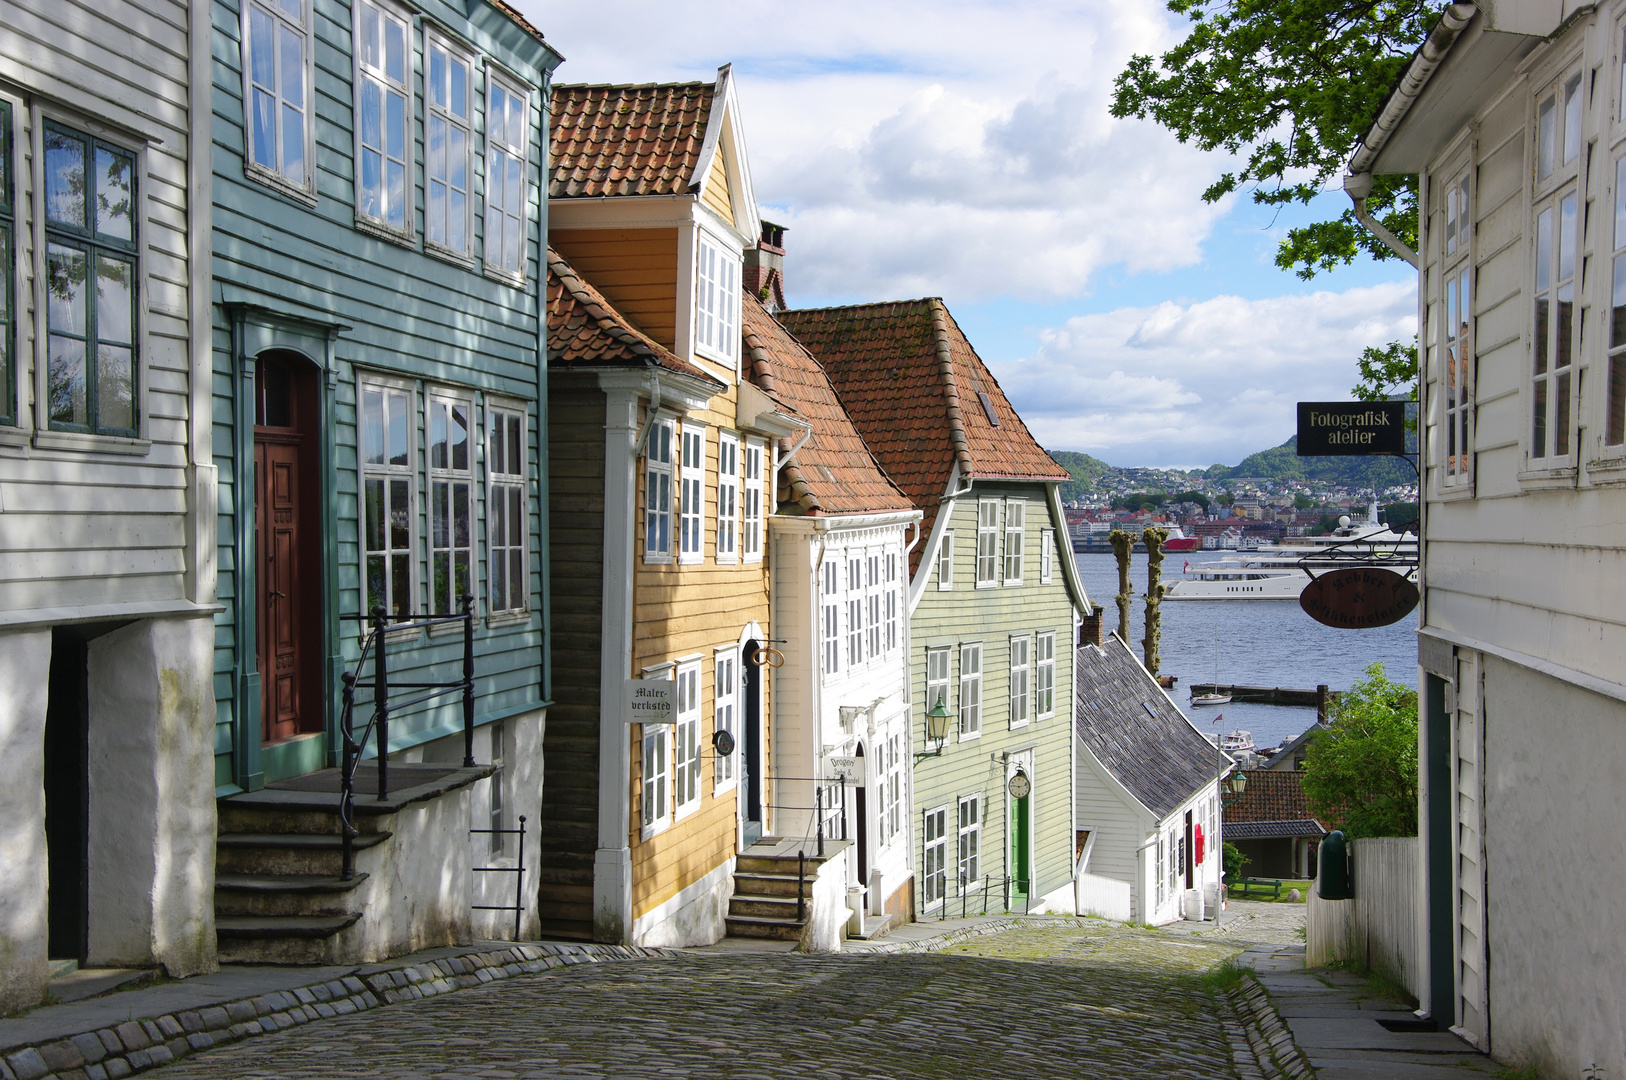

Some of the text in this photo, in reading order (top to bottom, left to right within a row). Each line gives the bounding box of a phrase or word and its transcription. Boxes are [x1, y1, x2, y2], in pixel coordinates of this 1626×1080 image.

[1310, 410, 1390, 429] Fotografisk
[1328, 429, 1376, 444] atelier
[635, 687, 667, 698] Maler-
[631, 700, 671, 711] verksted
[830, 758, 856, 767] Drogeri
